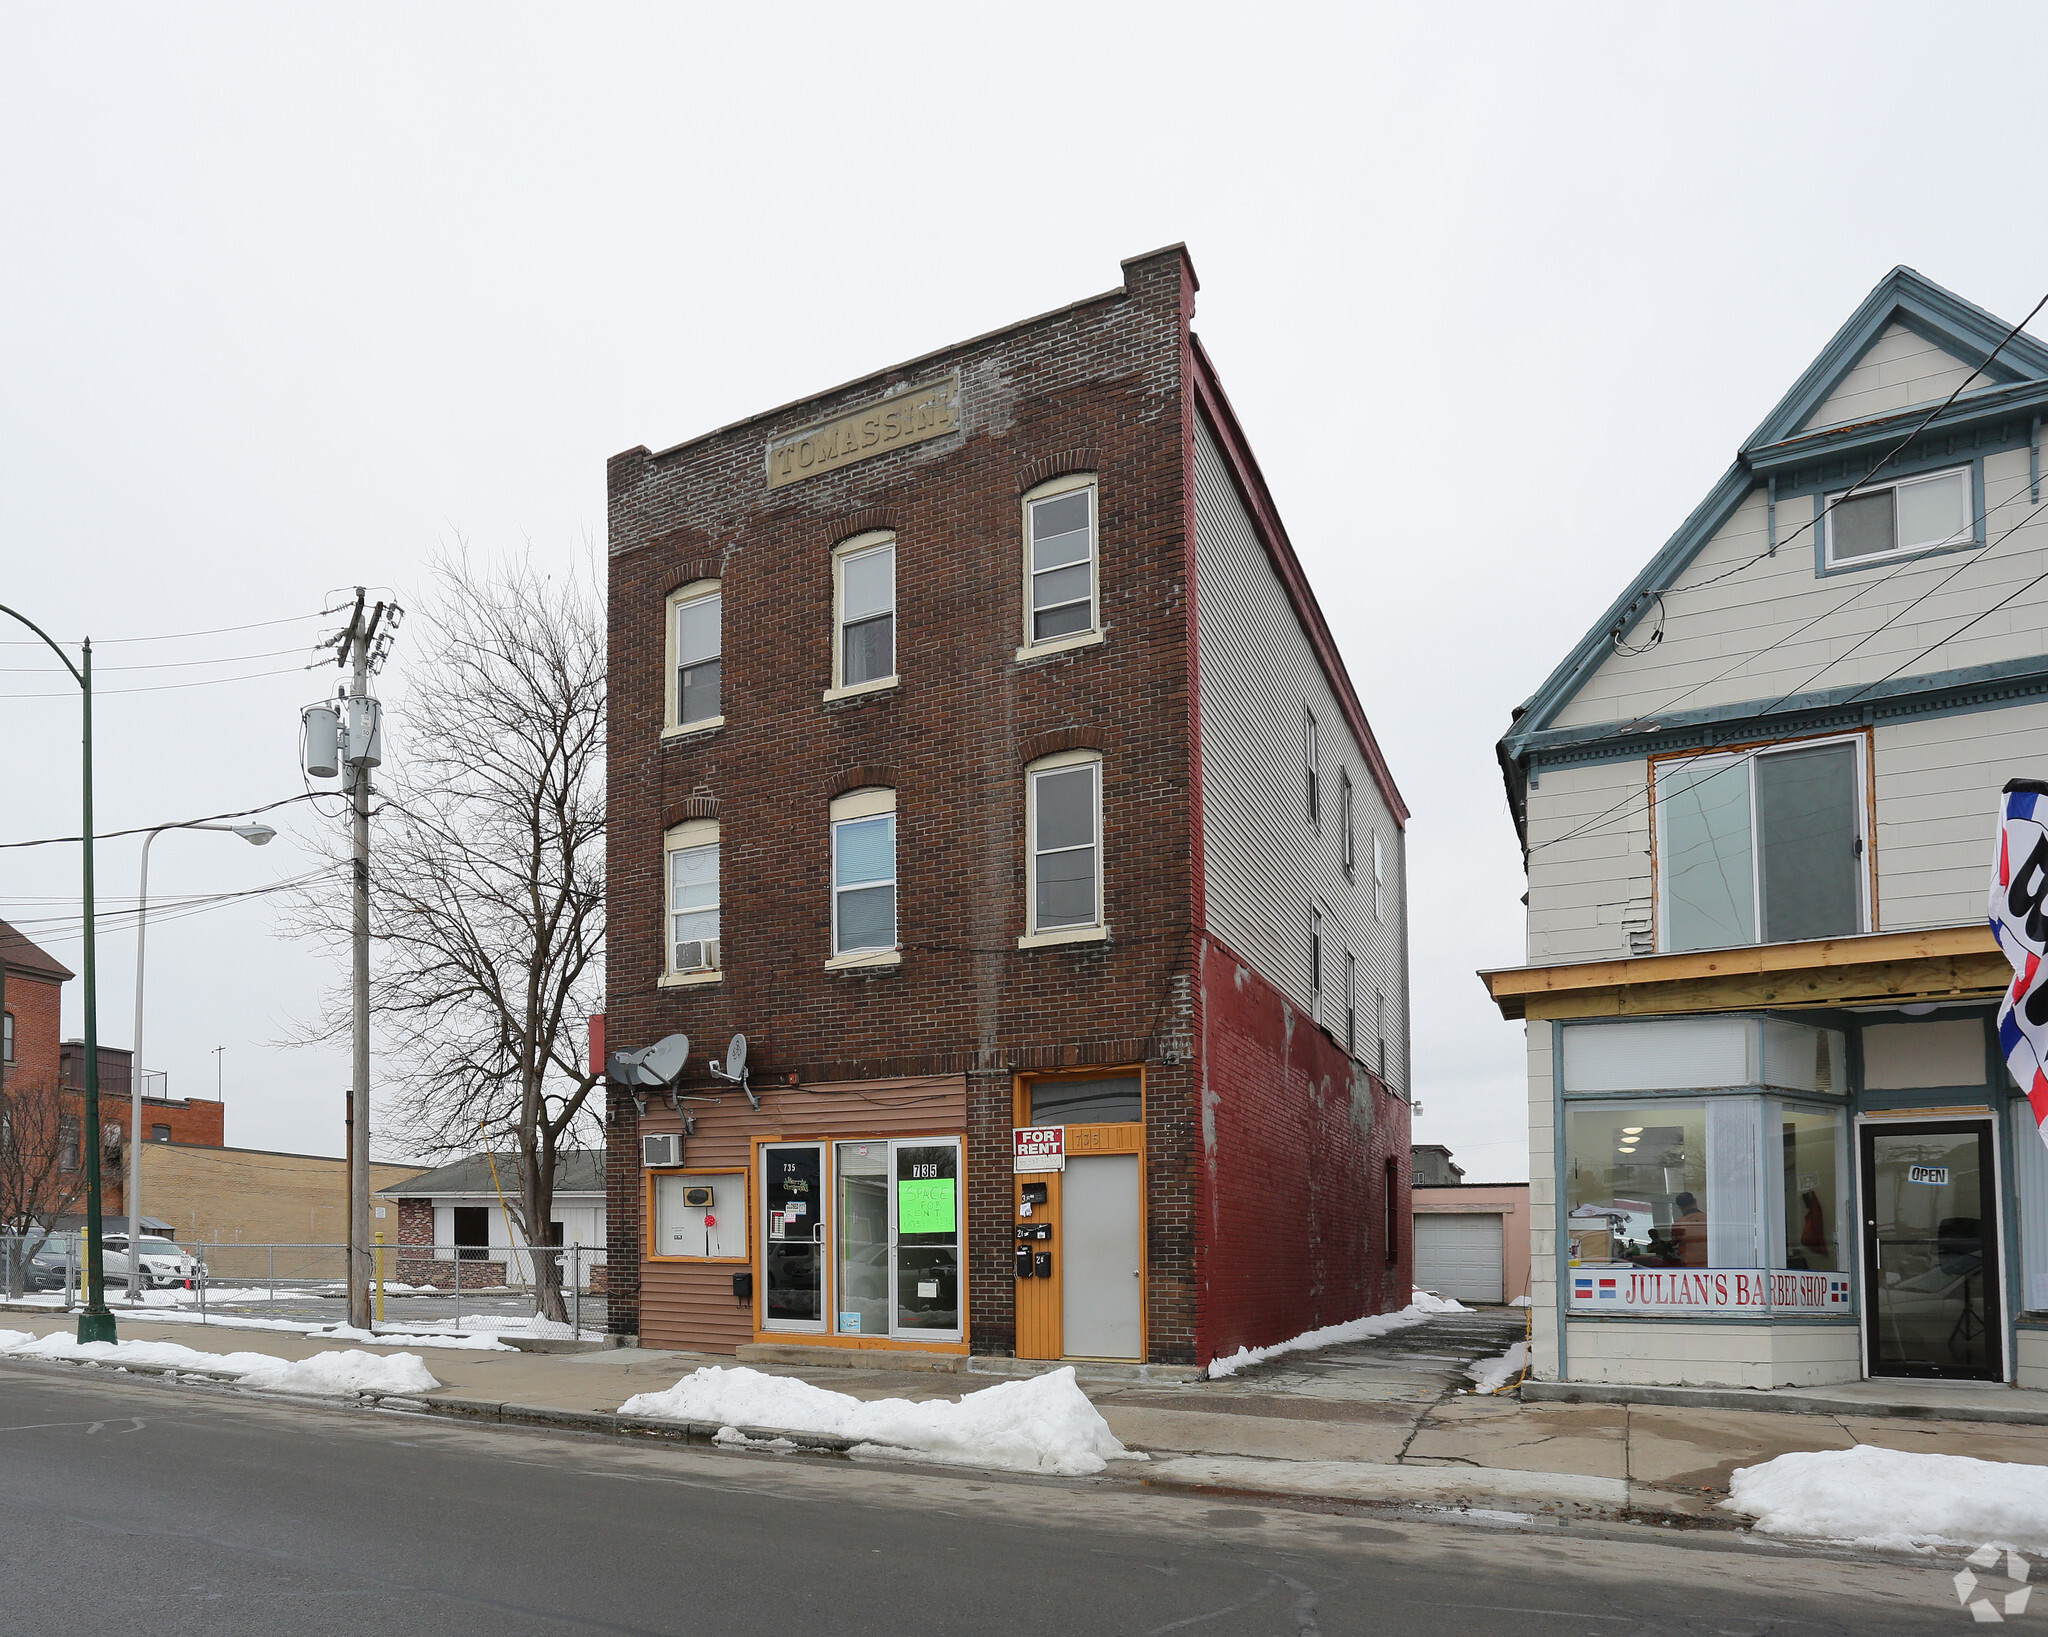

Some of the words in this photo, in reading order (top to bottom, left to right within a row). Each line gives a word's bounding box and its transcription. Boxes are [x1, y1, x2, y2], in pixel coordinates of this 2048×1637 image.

[777, 394, 949, 475] TOMASSINI
[1022, 1130, 1055, 1143] FOR
[1075, 1133, 1100, 1146] 735
[1017, 1142, 1060, 1155] RENT
[783, 1163, 796, 1172] 735
[913, 1165, 937, 1177] 735
[1911, 1167, 1945, 1183] OPEN
[906, 1185, 948, 1201] SPACE
[920, 1201, 942, 1210] FOR
[906, 1209, 942, 1218] RENT
[1626, 1273, 1727, 1306] JULIAN'S
[1735, 1274, 1797, 1306] BARBER
[1801, 1275, 1828, 1307] SHOP
